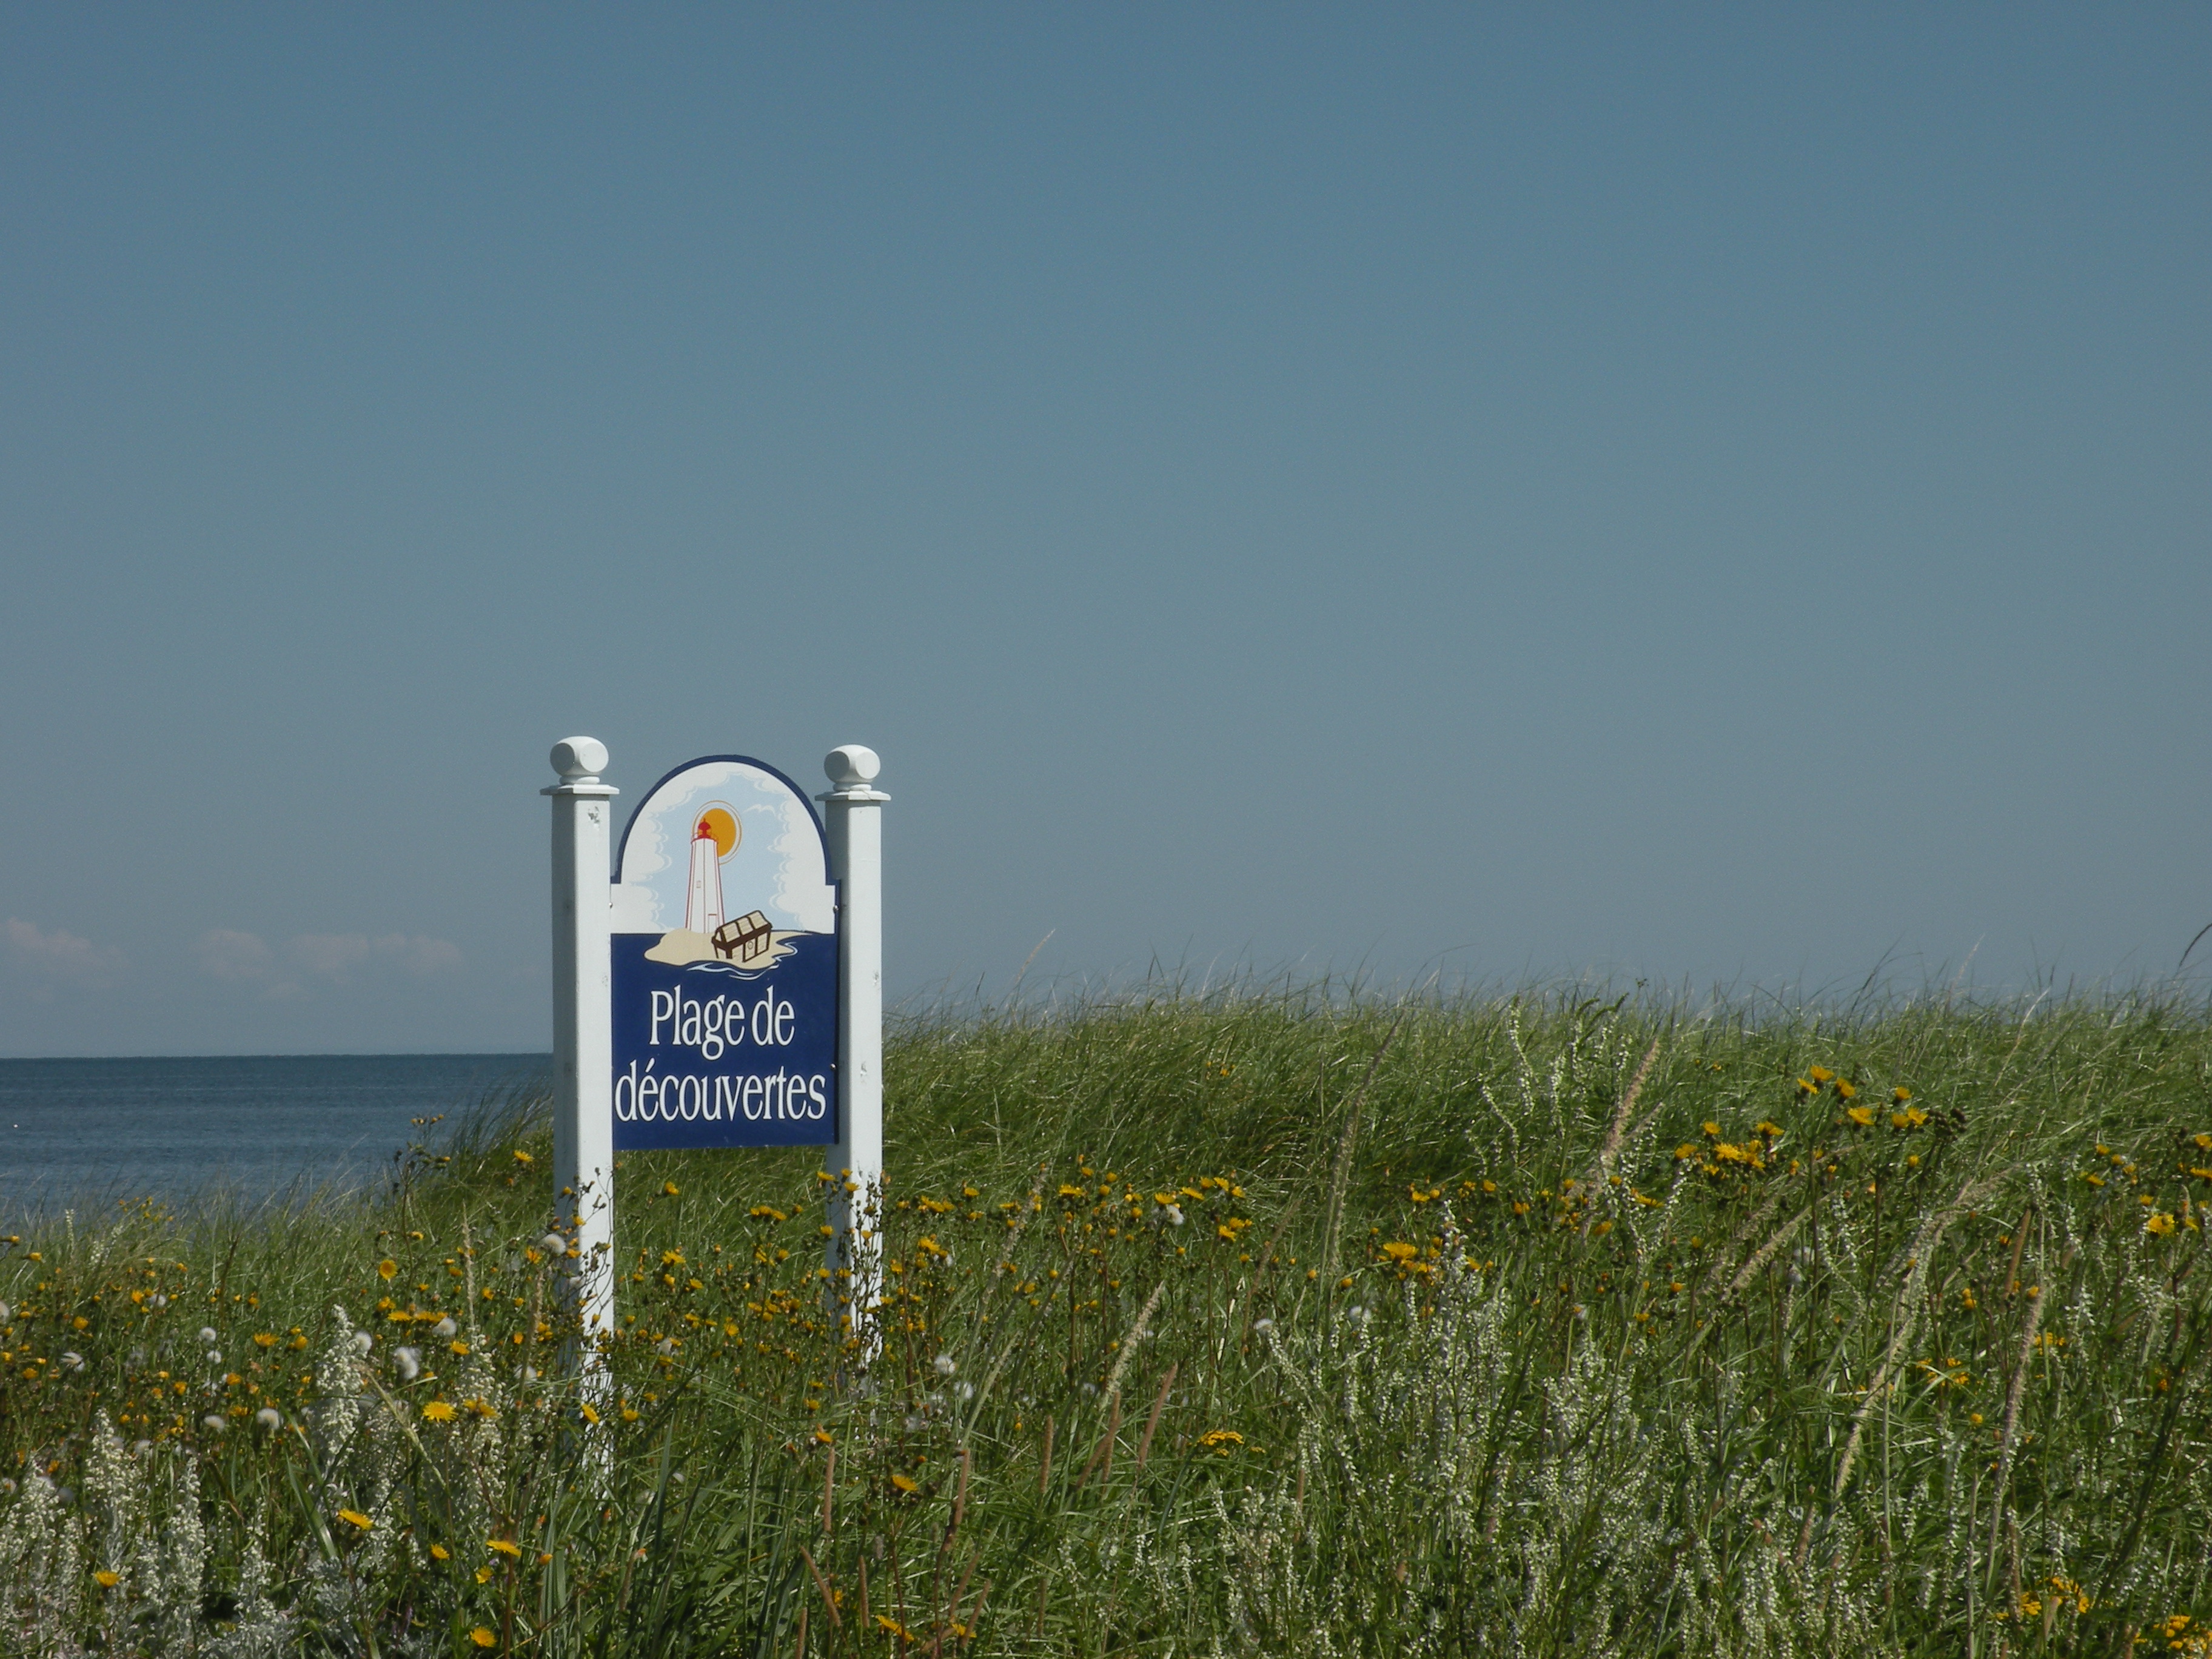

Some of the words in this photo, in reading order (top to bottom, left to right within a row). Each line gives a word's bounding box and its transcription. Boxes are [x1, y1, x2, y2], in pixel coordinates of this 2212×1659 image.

[649, 984, 745, 1061] Plage
[751, 985, 795, 1046] de
[615, 1057, 826, 1121] découvertes
